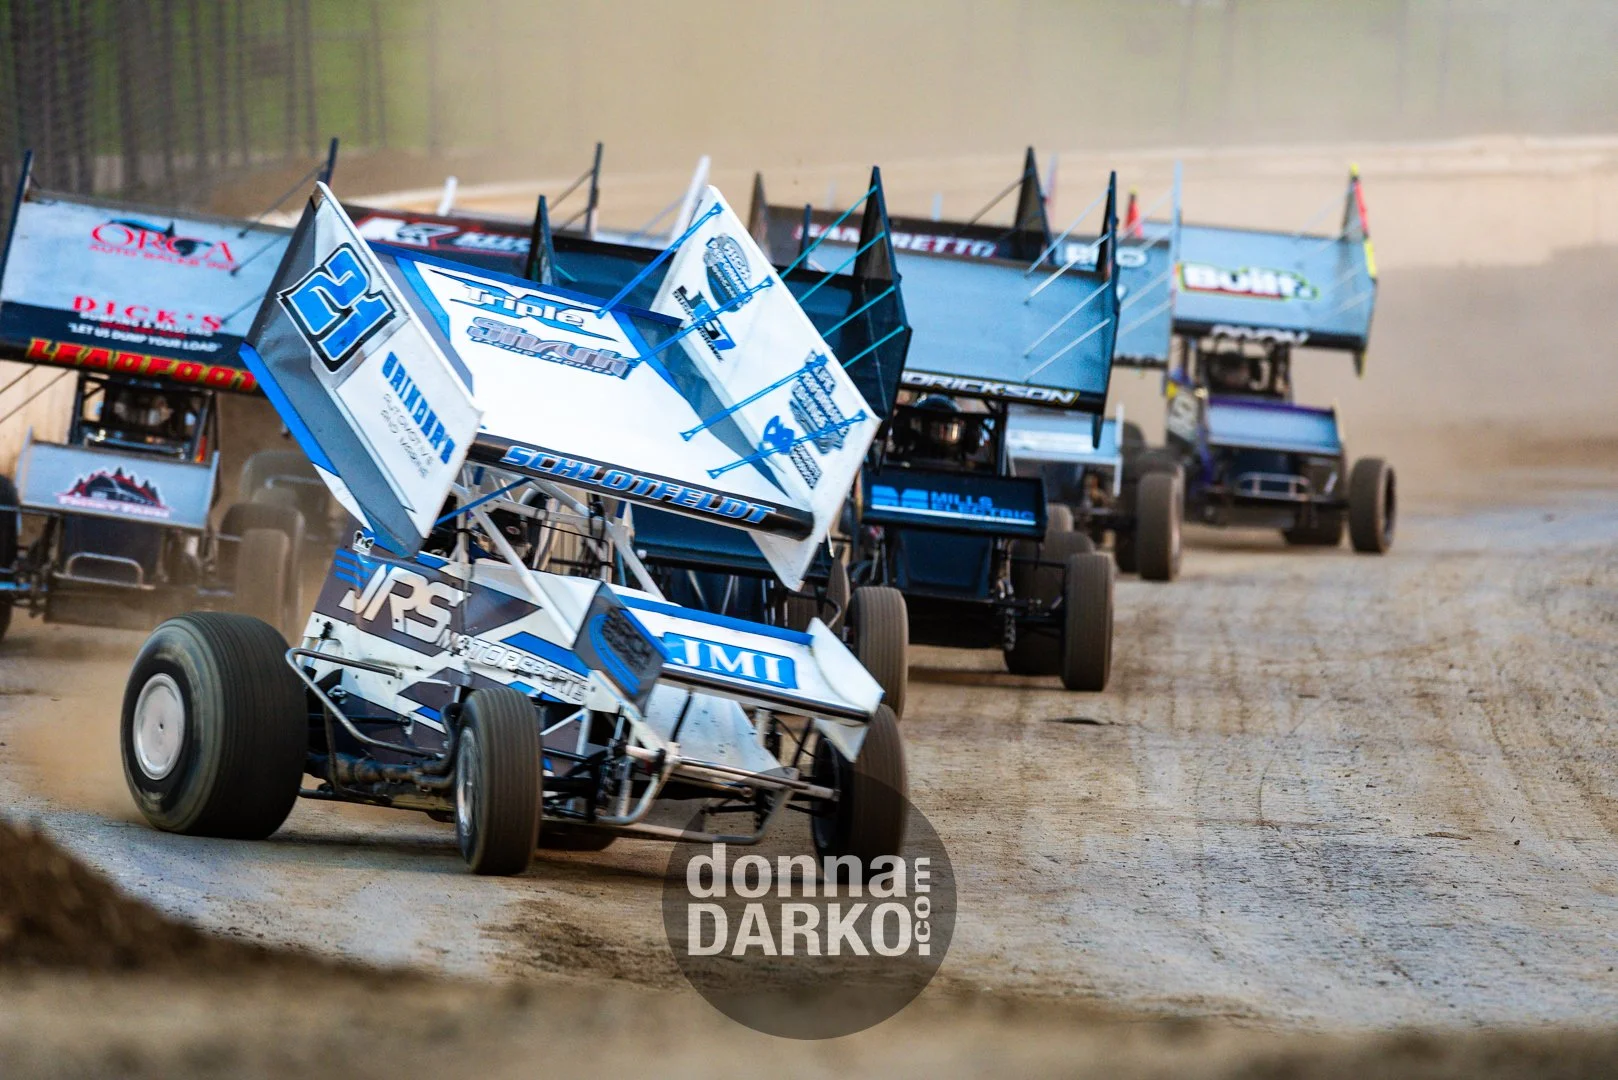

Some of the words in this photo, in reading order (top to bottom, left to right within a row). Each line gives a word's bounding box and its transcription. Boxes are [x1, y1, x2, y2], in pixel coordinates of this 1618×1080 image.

[73, 296, 222, 331] DICK'S
[283, 245, 395, 366] 21
[464, 284, 584, 327] Triple
[94, 327, 111, 339] US
[111, 329, 147, 343] DUMP
[501, 445, 777, 524] SCHLOTFELDT
[931, 490, 993, 509] MILLS
[338, 564, 472, 643] JRS
[672, 637, 784, 685] JMI
